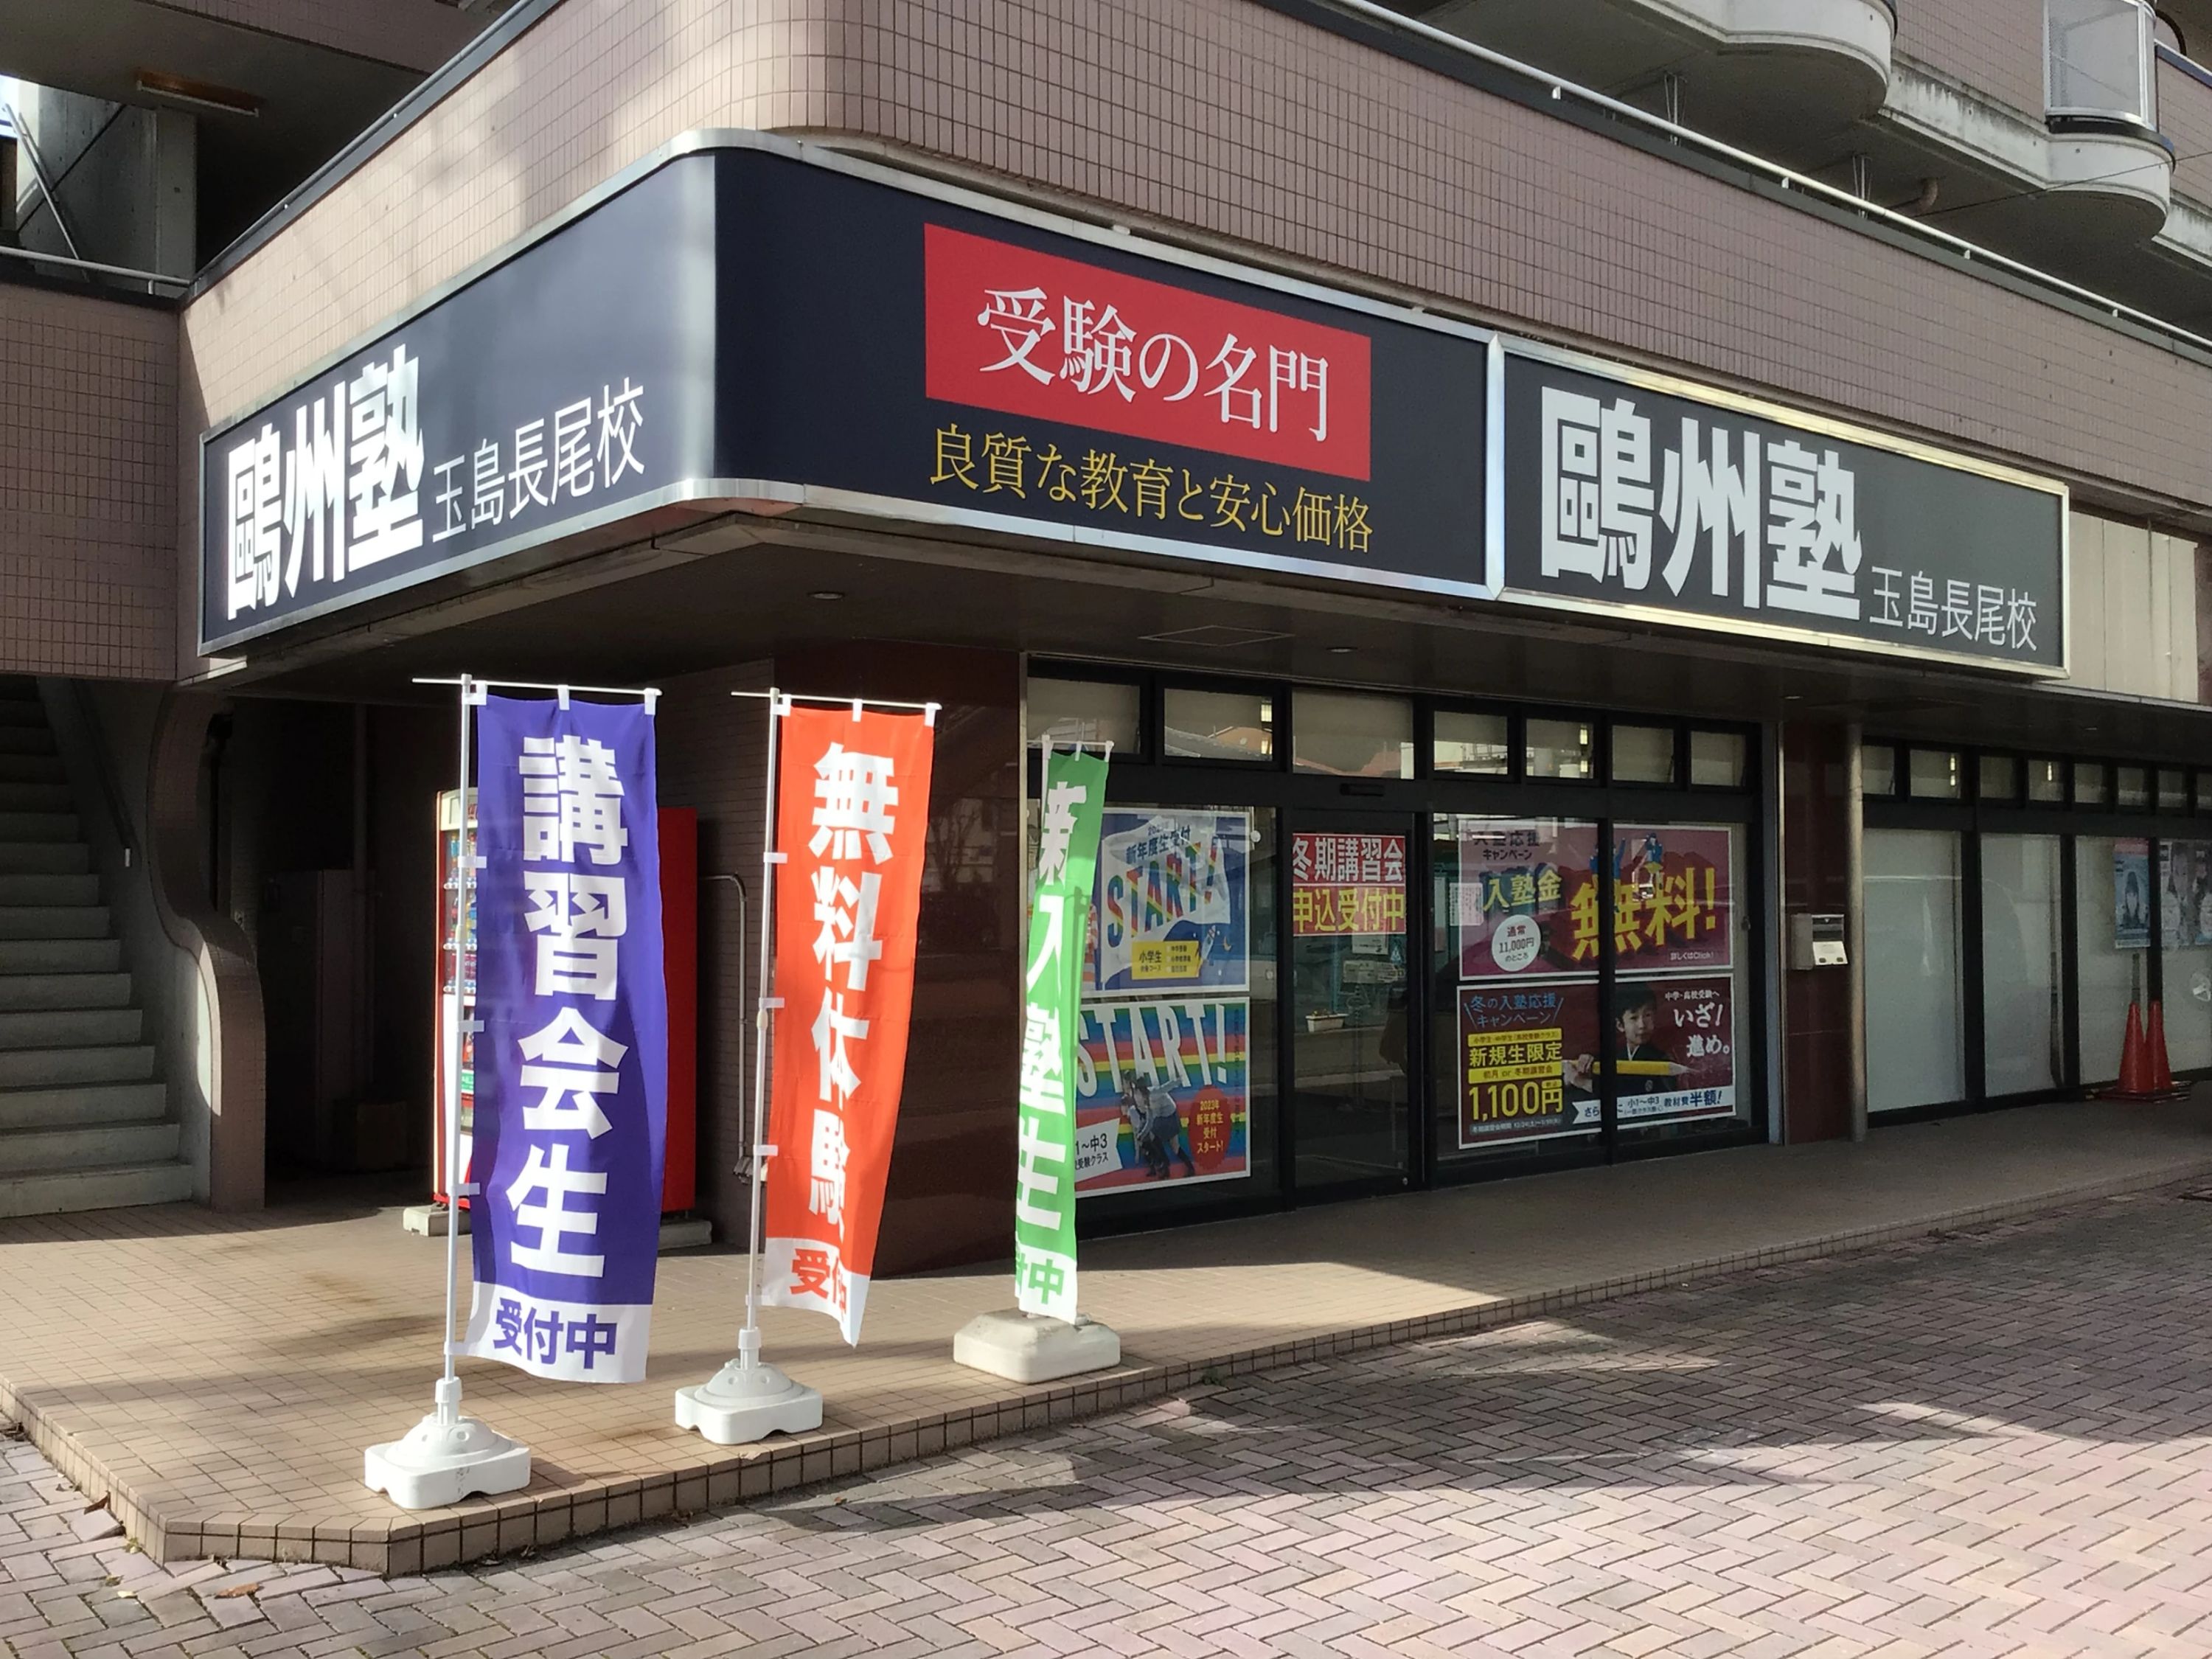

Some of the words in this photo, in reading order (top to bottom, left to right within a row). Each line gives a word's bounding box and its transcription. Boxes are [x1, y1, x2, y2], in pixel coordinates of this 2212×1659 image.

[977, 286, 1329, 442] 受験の名門
[432, 377, 644, 543] 玉島長尾校
[931, 422, 1374, 554] 良質な教育と安心価格
[1869, 566, 2037, 651] 玉島長尾校
[1126, 825, 1191, 864] 新年度生受付
[1293, 837, 1403, 882] 冬期講習会
[1483, 849, 1533, 860] キャンペーン
[1107, 838, 1217, 948] START!
[1293, 887, 1405, 933] 申込受付中
[1483, 869, 1562, 912] 入塾金
[1139, 950, 1162, 964] 小学生
[1499, 937, 1534, 954] 11,000円
[506, 734, 629, 1279] 講習会生
[1471, 992, 1557, 1013] 冬の入塾応援
[1477, 1012, 1551, 1028] キャンペーン
[1470, 1042, 1562, 1067] 新規生限定
[1686, 1034, 1731, 1057] 進め。
[1197, 1112, 1223, 1125] 新年度生
[1469, 1082, 1563, 1121] 1,100円
[1203, 1127, 1217, 1139] 受付
[493, 1297, 618, 1369] 受付中
